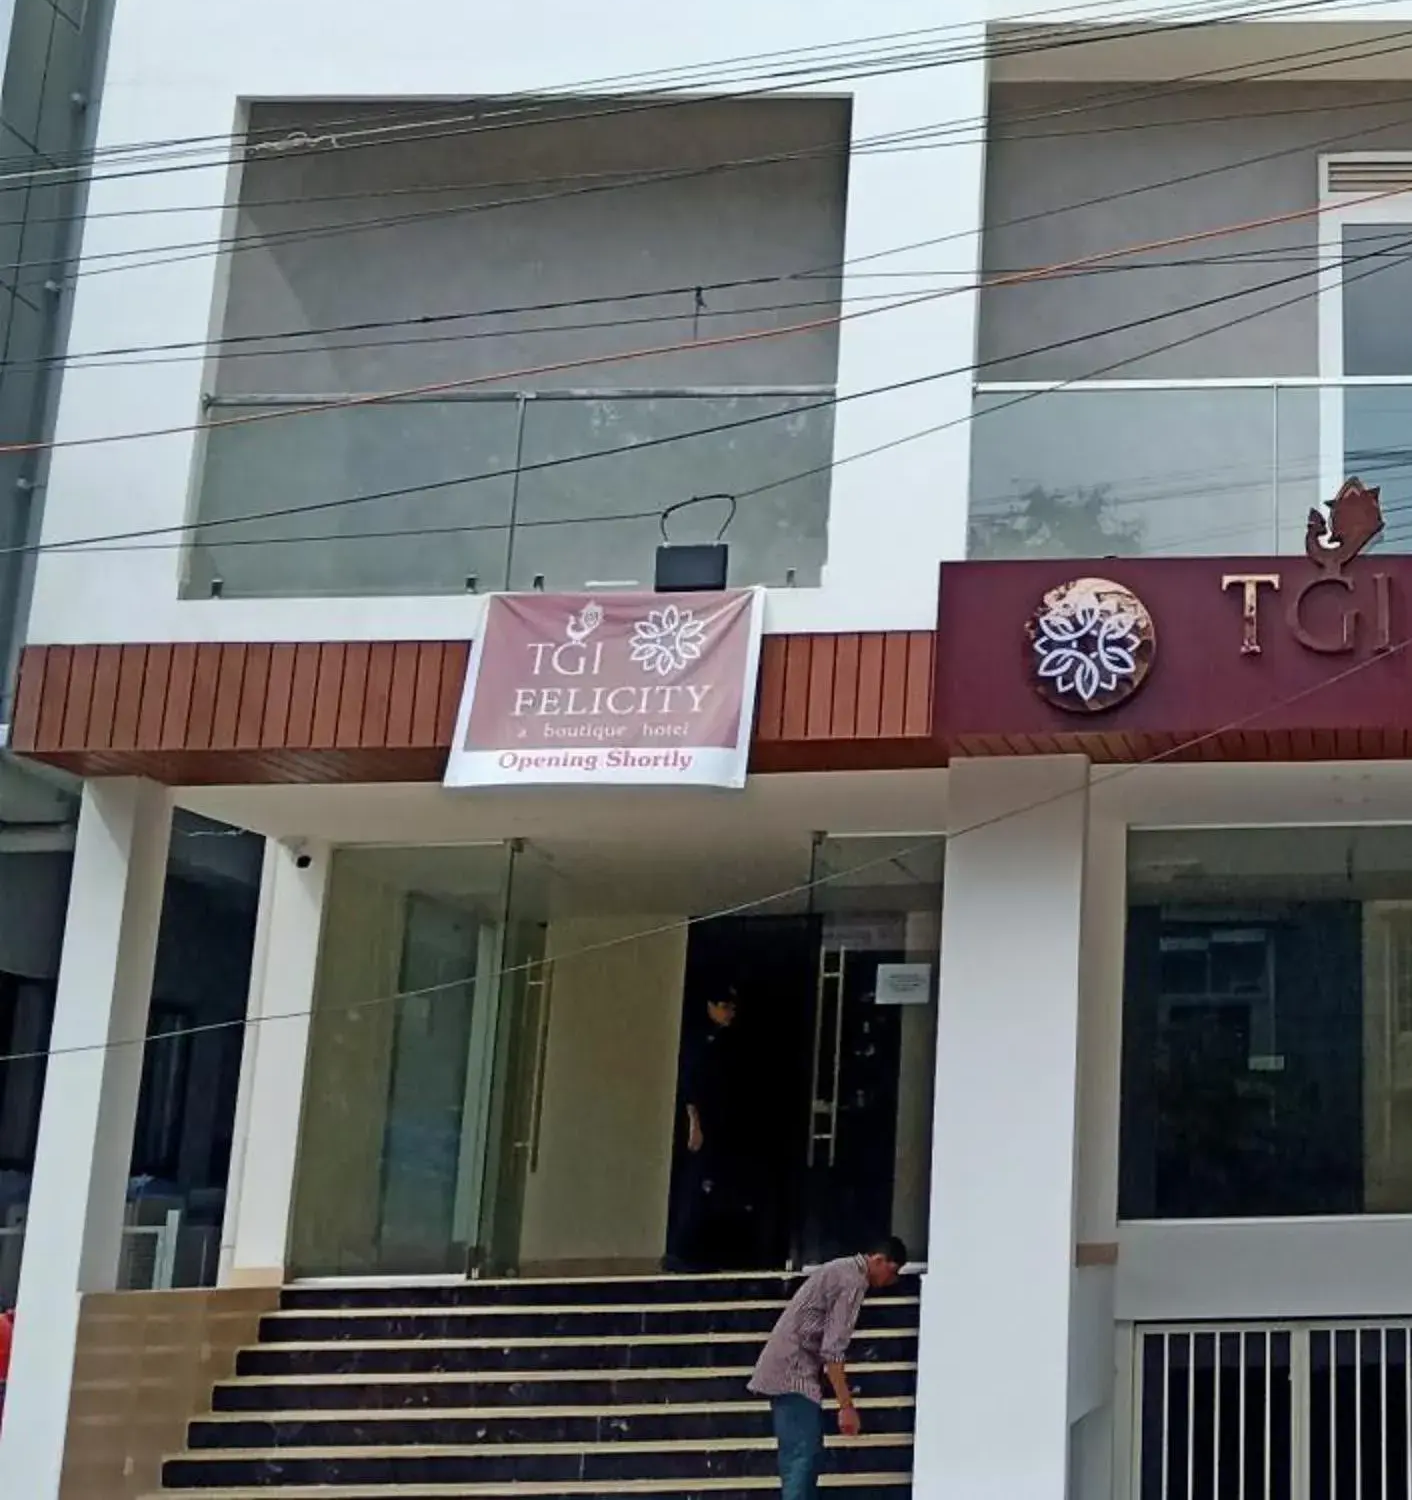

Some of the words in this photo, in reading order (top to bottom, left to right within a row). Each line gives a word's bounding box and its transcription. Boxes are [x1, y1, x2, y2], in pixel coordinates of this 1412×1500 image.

[1221, 572, 1393, 655] TGI
[527, 641, 602, 676] TGI
[511, 685, 713, 717] FELICITY
[517, 727, 527, 739] a
[543, 722, 627, 742] boutique
[642, 721, 689, 737] hotel
[498, 750, 600, 772] Opening
[605, 748, 693, 772] Shortly
